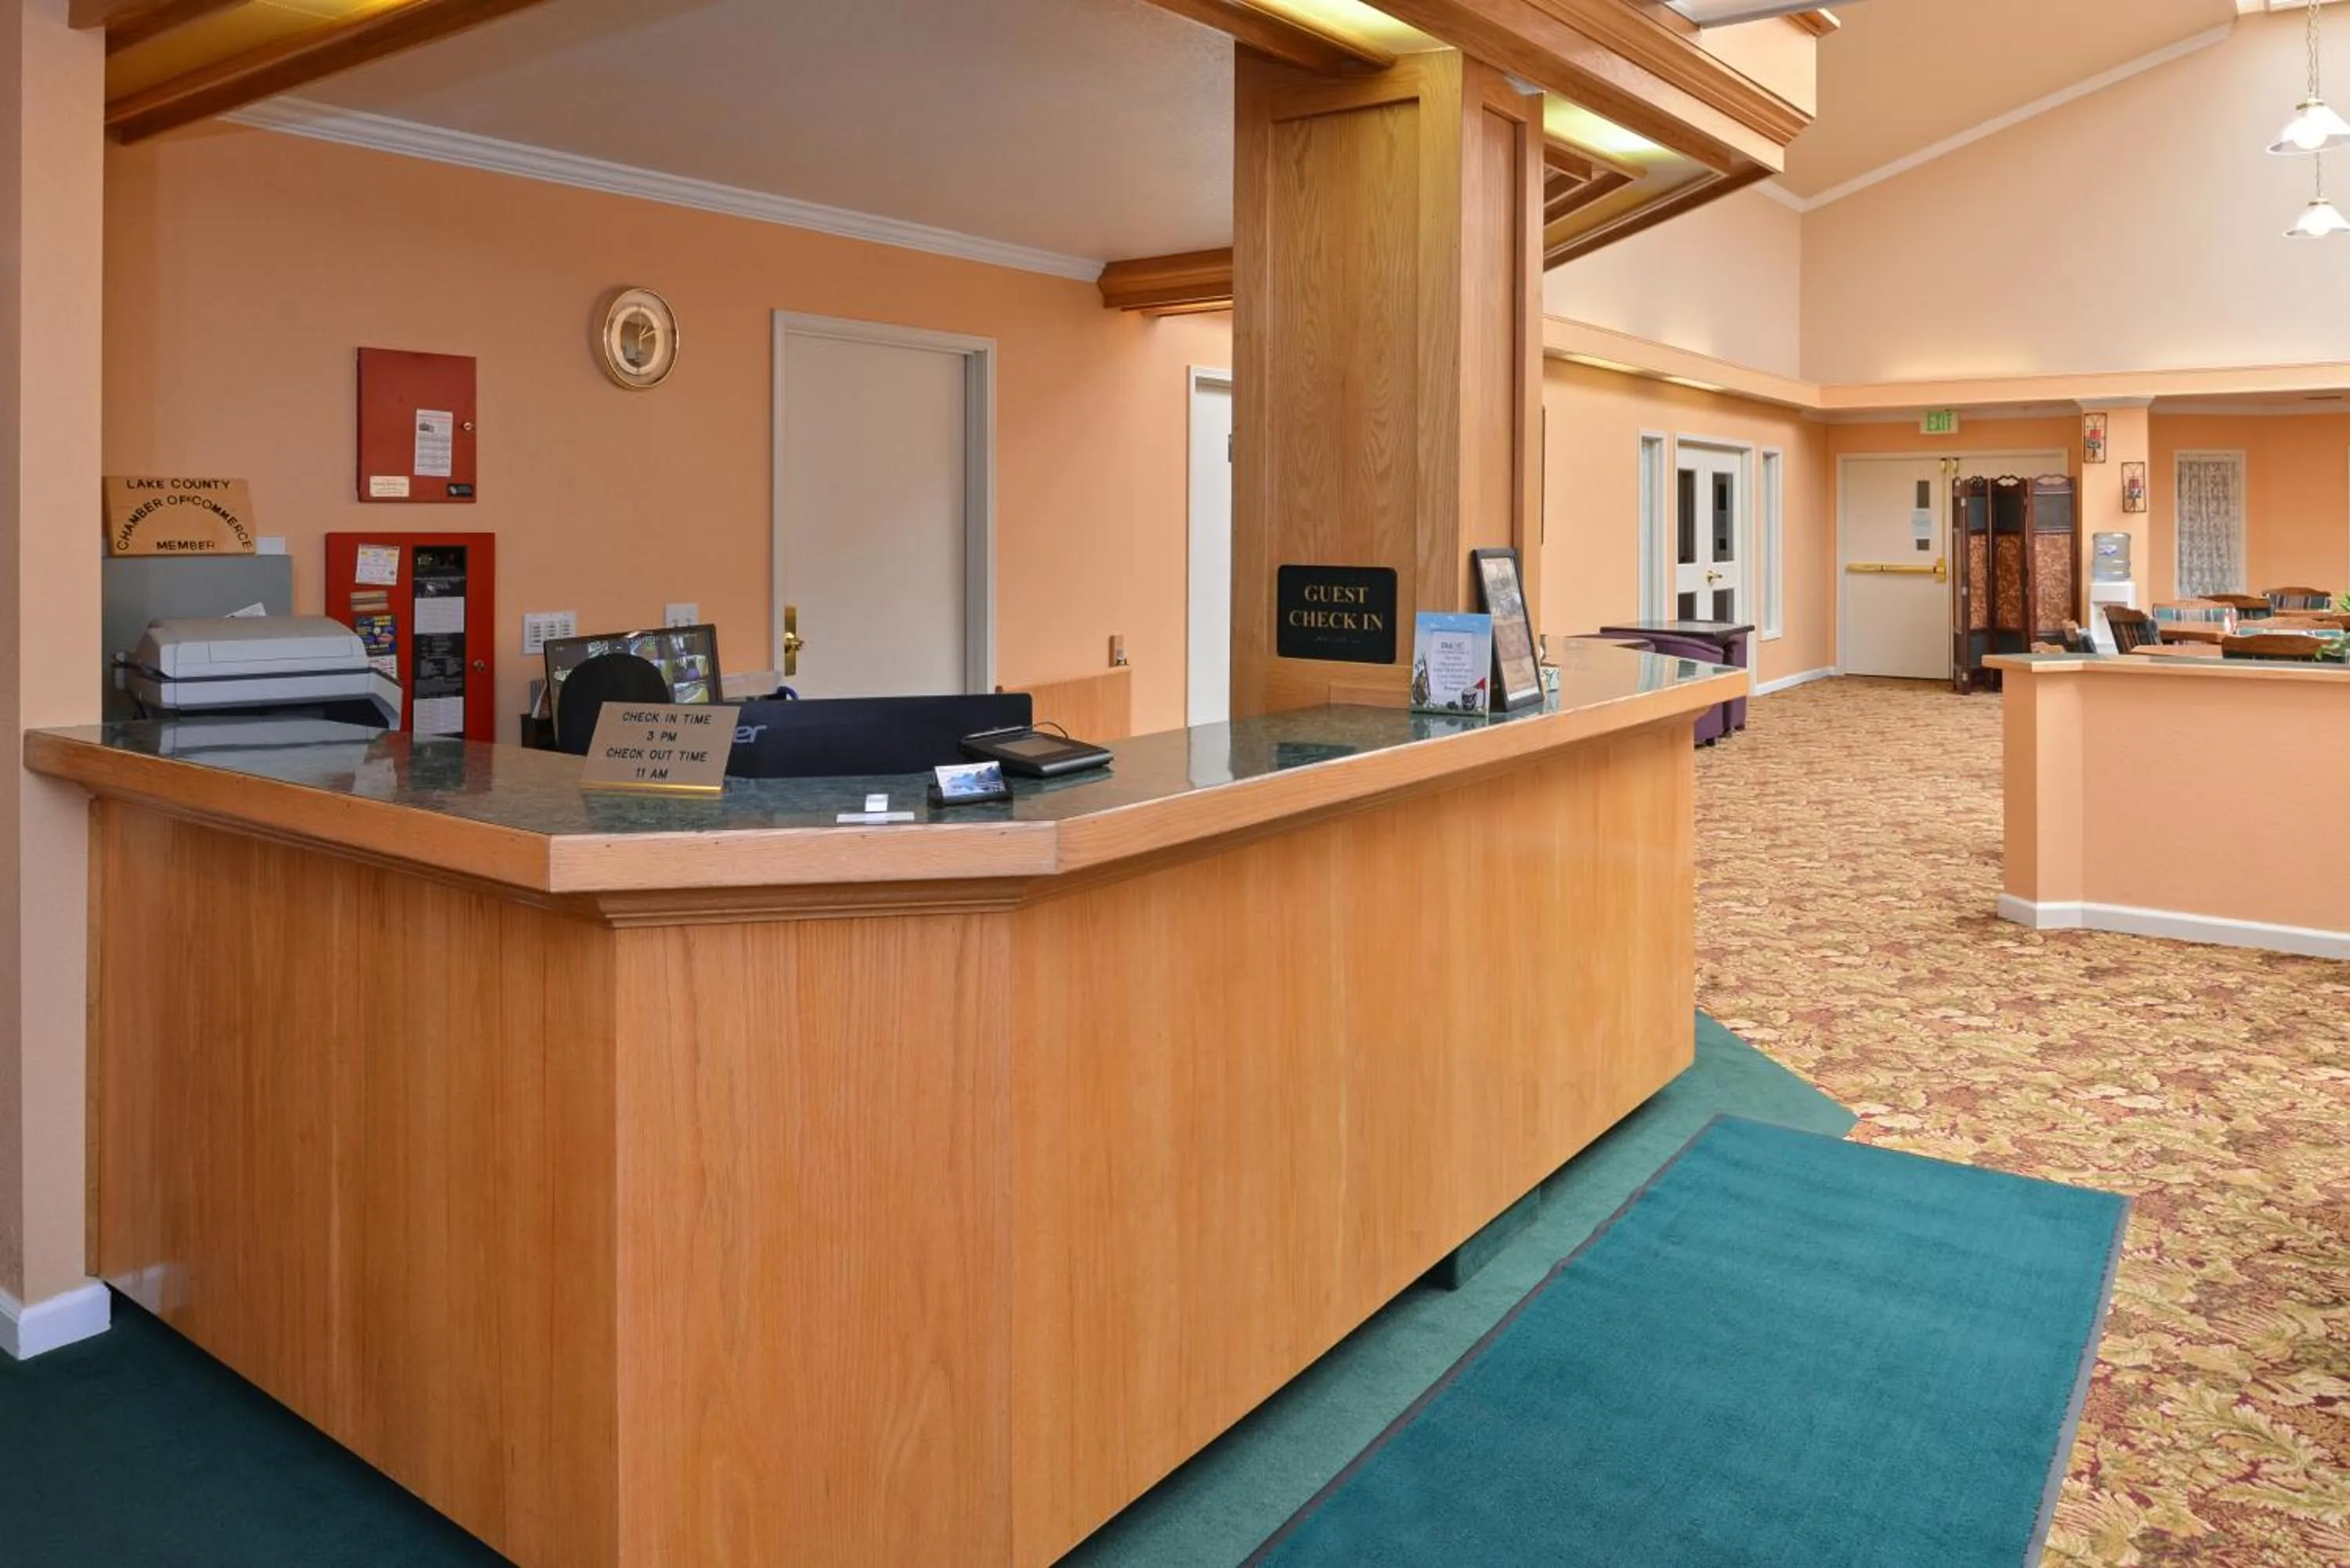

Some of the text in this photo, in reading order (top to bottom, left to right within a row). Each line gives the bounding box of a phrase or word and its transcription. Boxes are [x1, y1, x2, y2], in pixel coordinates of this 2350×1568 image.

[1927, 412, 1953, 431] EXIT
[126, 479, 231, 490] LAKE COUNTY
[117, 495, 253, 551] CHAMBER OF COMMERCE
[156, 540, 216, 550] MEMBER
[1303, 584, 1370, 604] GUEST
[1289, 609, 1384, 633] CHECK IN
[622, 711, 712, 724] CHECK IN TIME
[646, 731, 678, 742] 3 PM
[732, 725, 768, 743] er
[606, 747, 708, 762] CHECK OUT TIME
[636, 768, 668, 779] 11 AM
